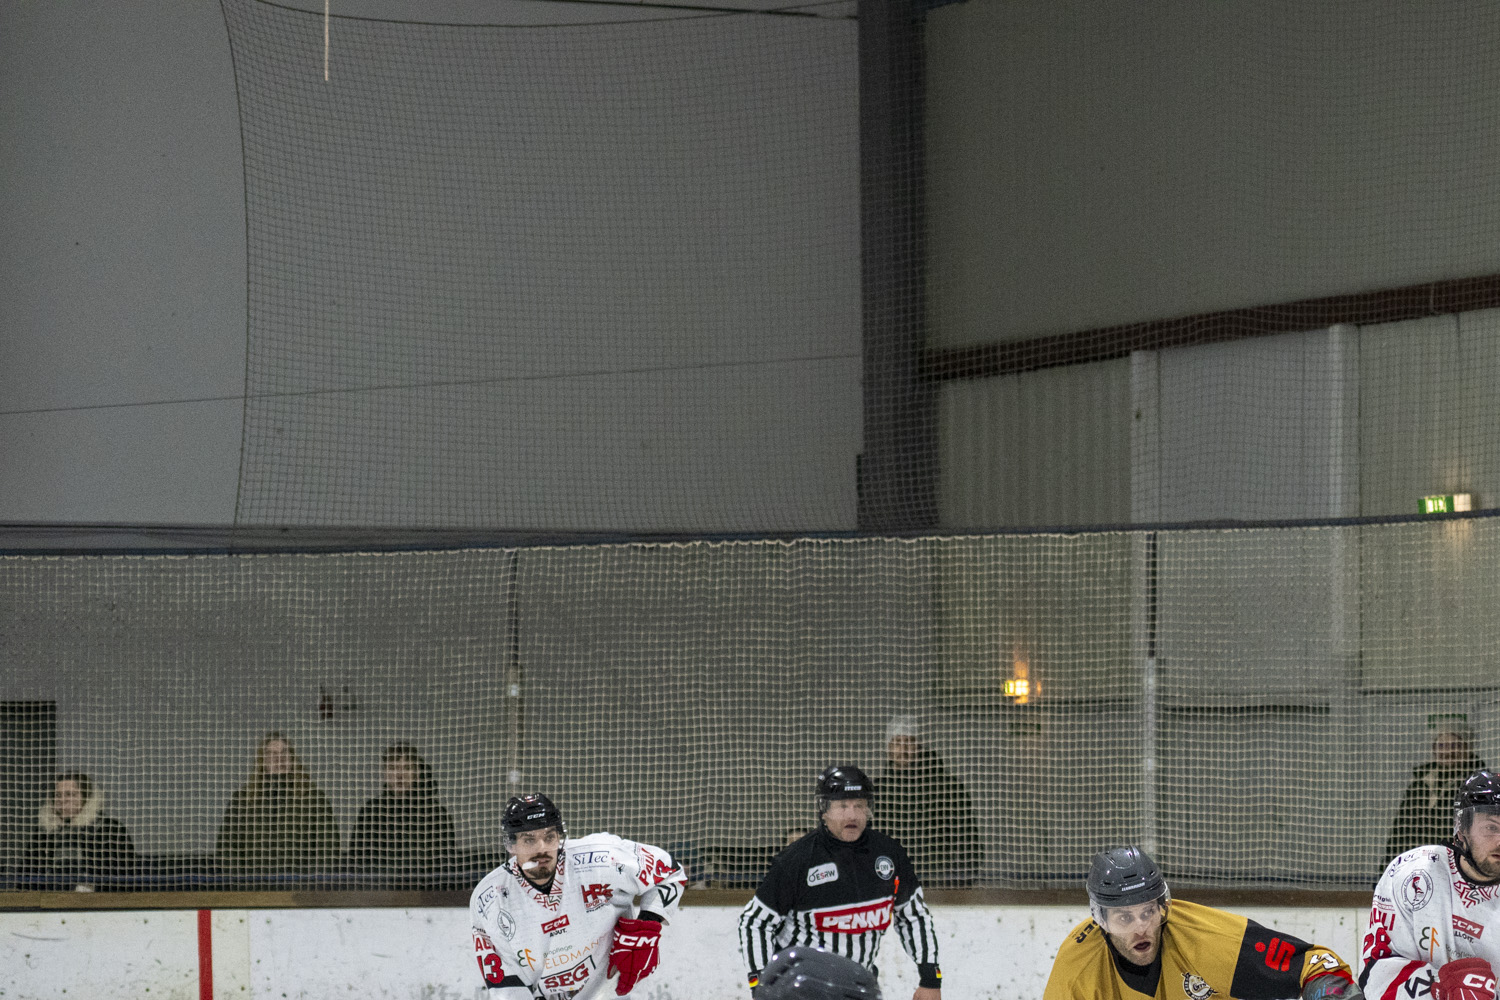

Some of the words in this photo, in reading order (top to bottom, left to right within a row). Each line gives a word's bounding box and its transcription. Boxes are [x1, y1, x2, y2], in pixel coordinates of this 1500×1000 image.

[526, 812, 546, 820] CCM
[822, 903, 893, 931] PENNY
[544, 963, 590, 989] SEG
